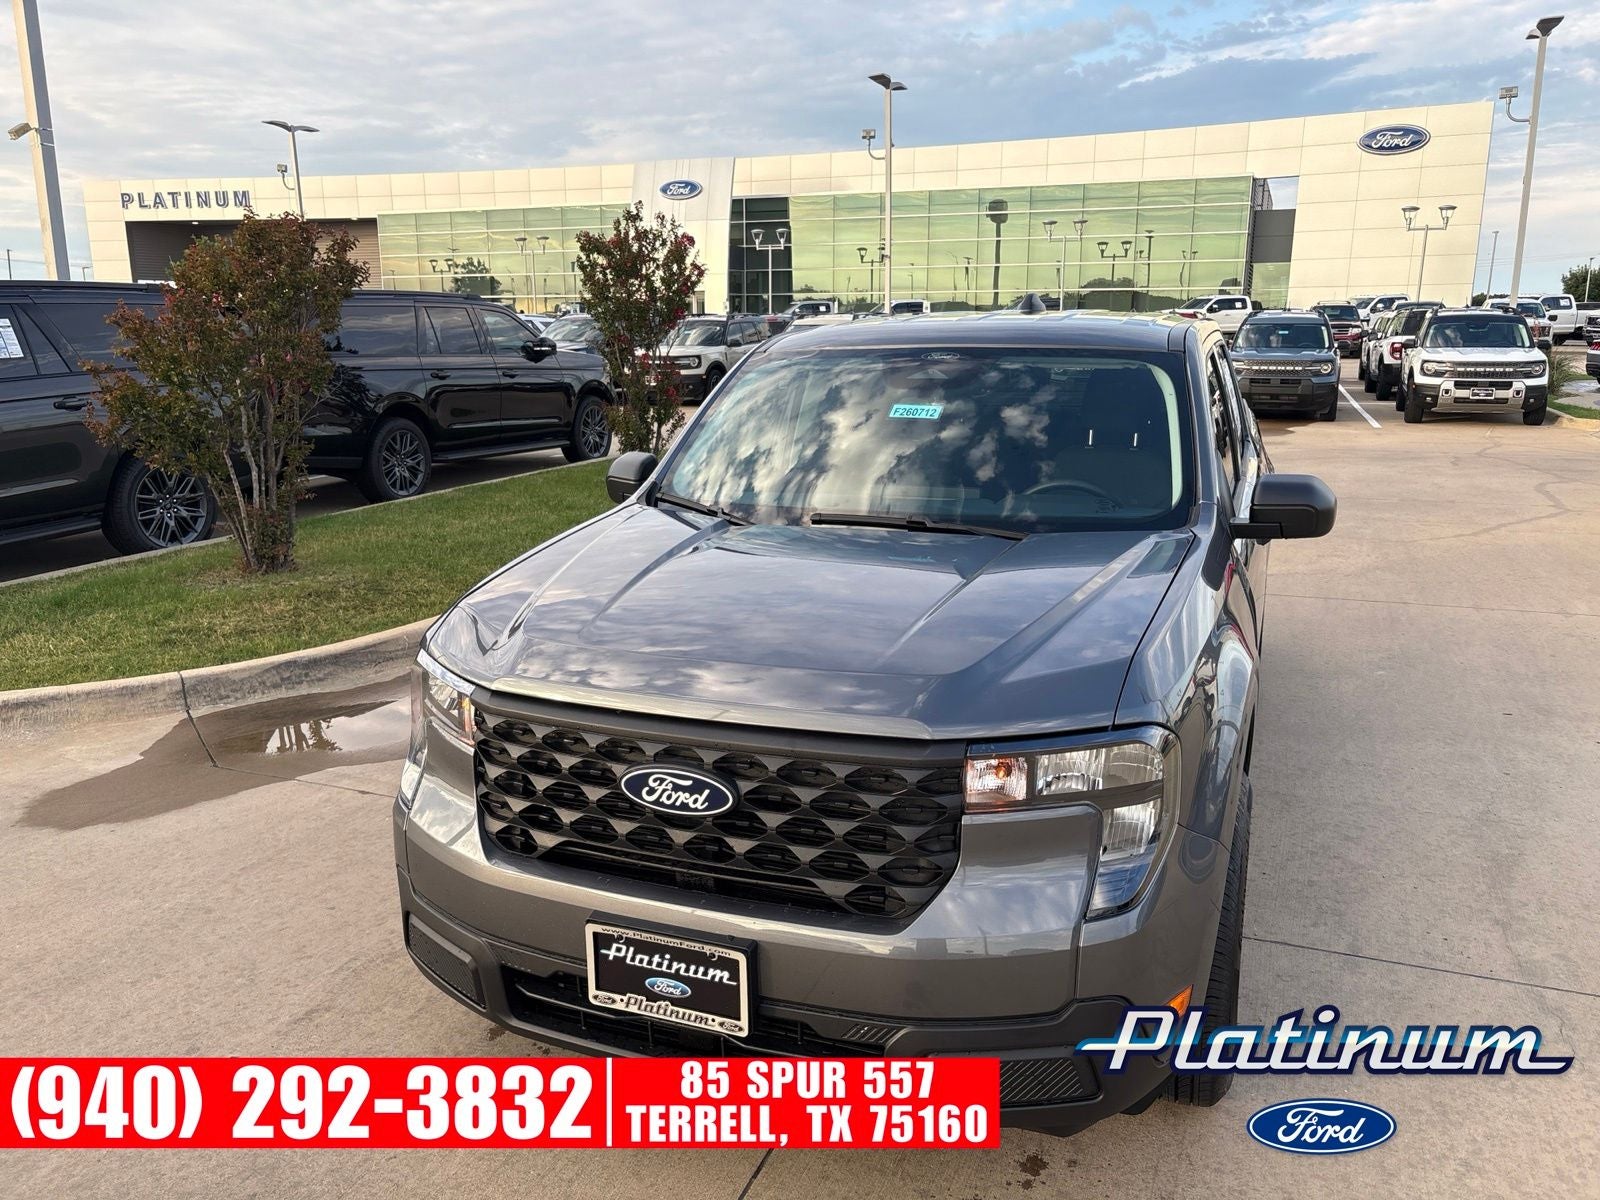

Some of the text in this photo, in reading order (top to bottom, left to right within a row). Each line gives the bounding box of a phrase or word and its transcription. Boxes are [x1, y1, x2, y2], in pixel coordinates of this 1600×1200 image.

[1371, 131, 1414, 148] Ford
[667, 183, 691, 195] Ford
[120, 190, 251, 209] PLATINUM
[893, 407, 937, 417] F260712
[641, 773, 710, 810] Ford
[601, 927, 731, 957] www.PlatinumFord.com
[600, 943, 738, 986] Platinum
[653, 977, 683, 997] Ford
[624, 993, 717, 1028] Platinum
